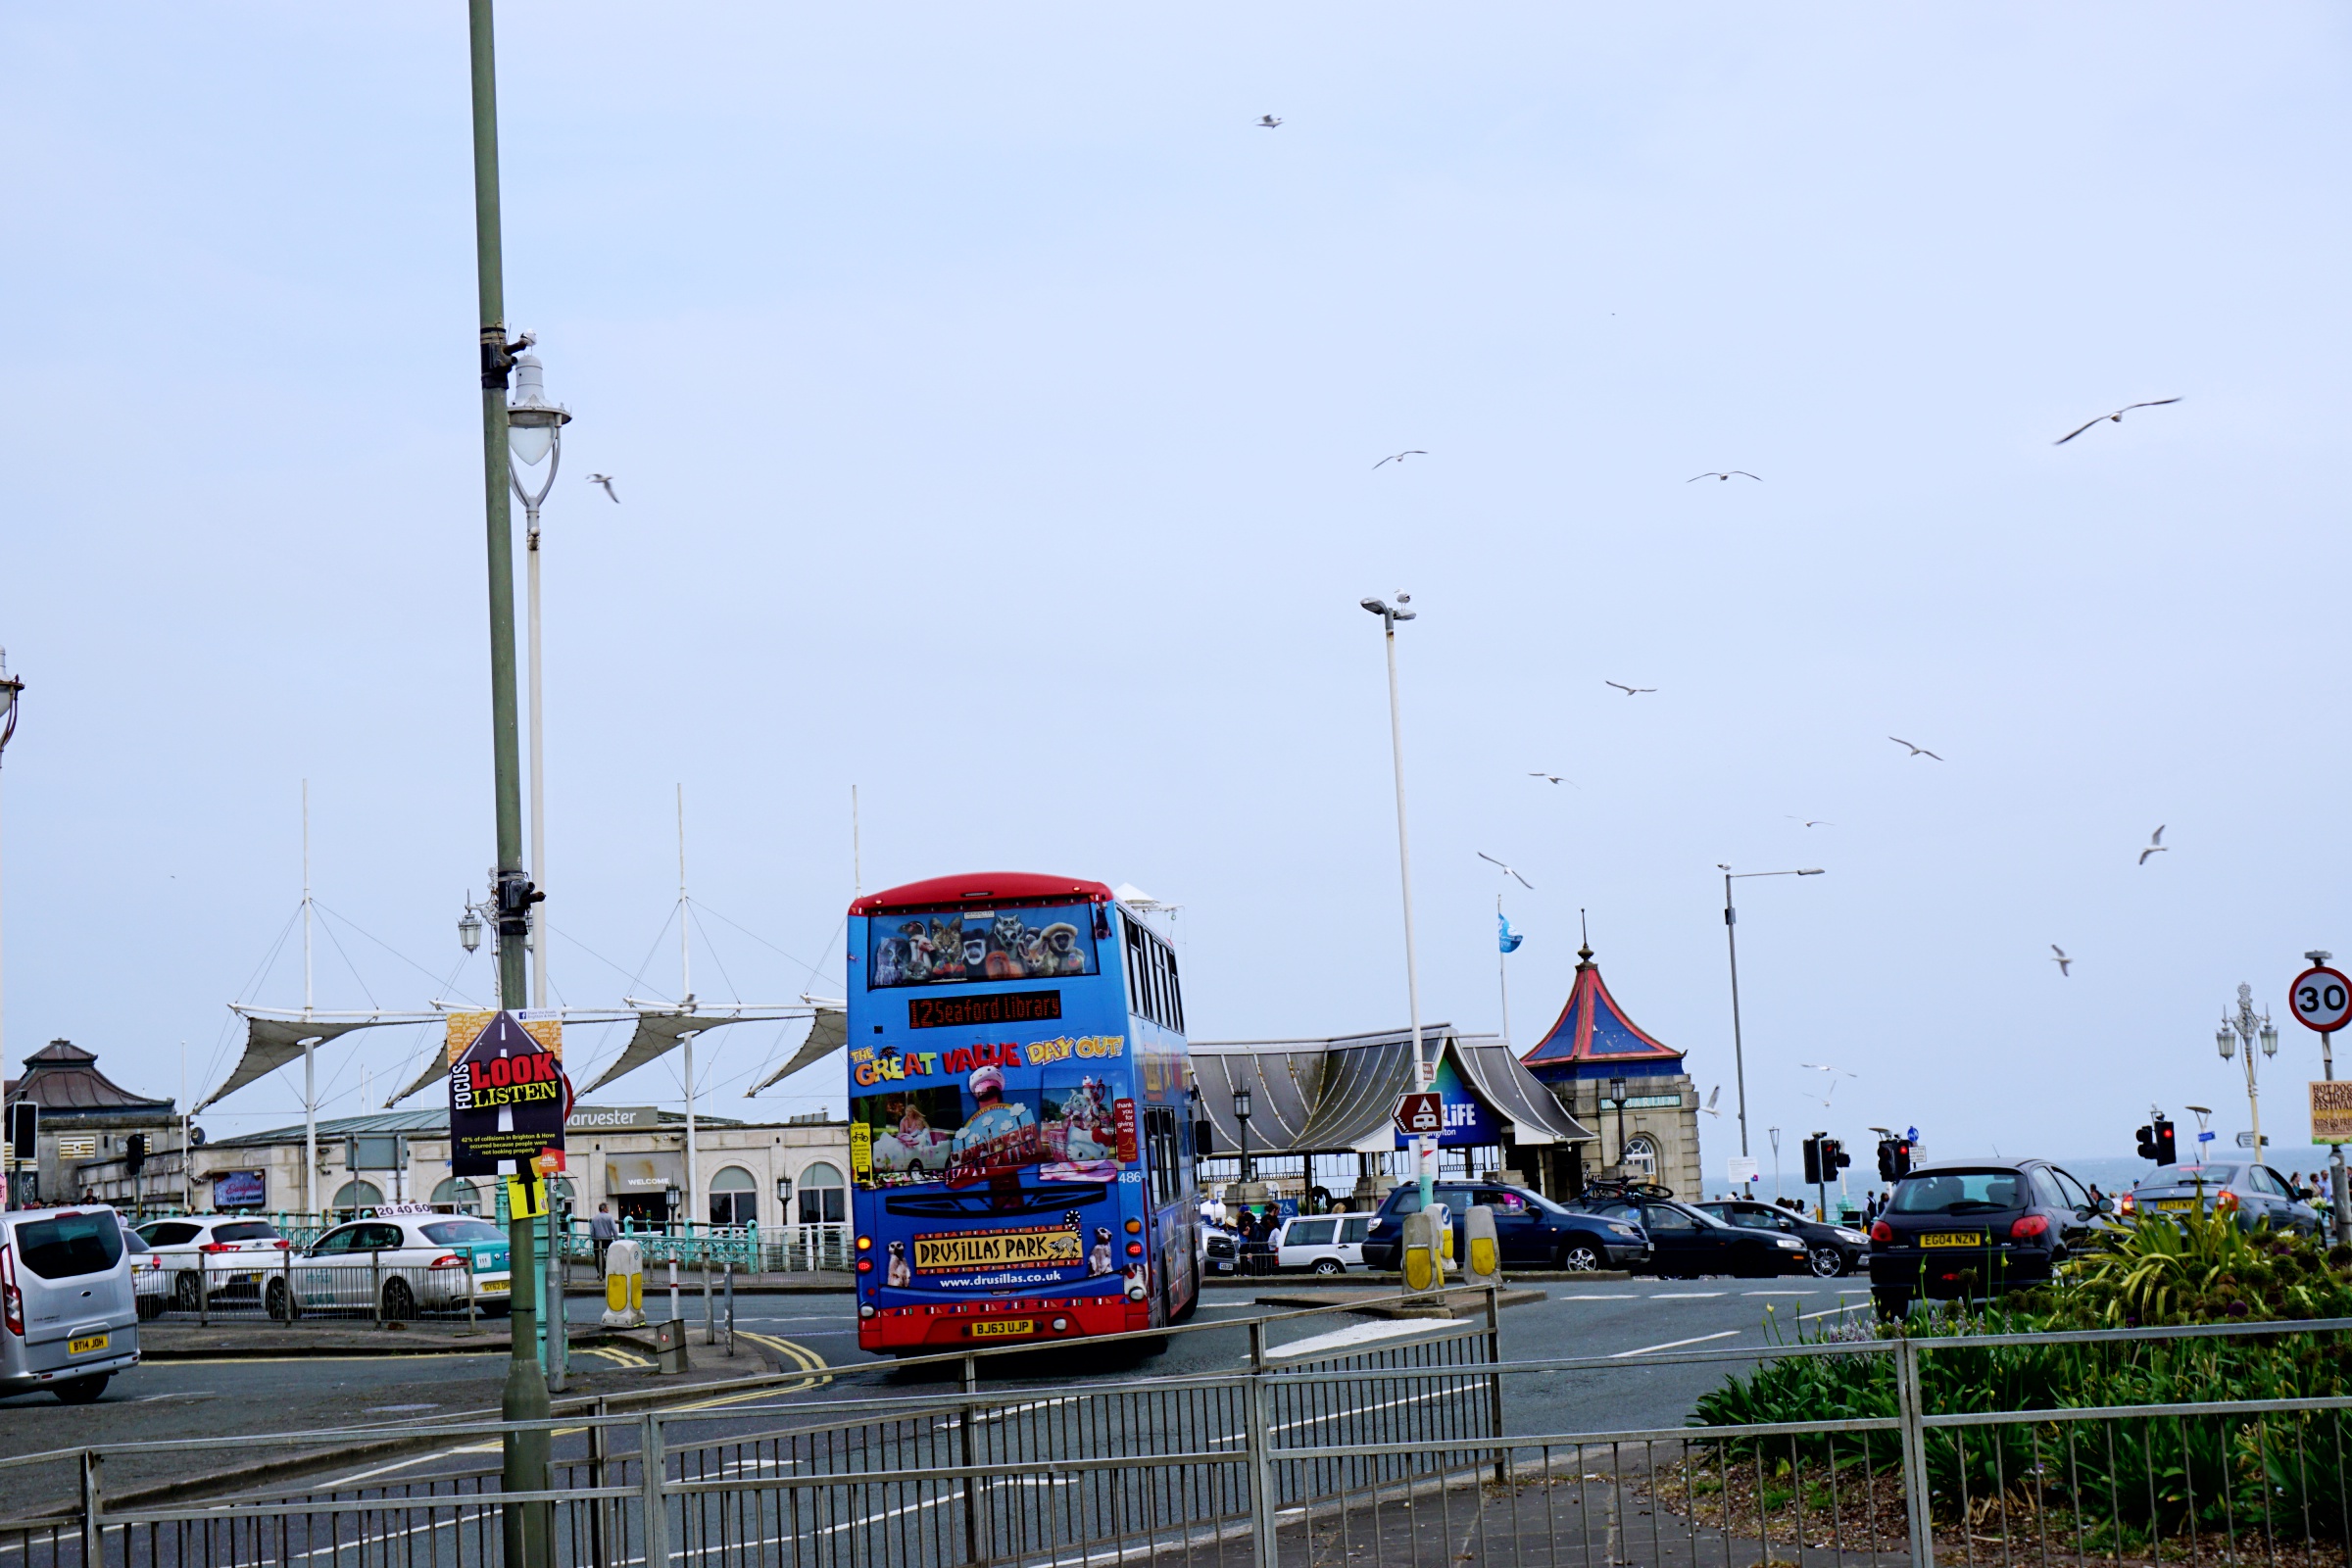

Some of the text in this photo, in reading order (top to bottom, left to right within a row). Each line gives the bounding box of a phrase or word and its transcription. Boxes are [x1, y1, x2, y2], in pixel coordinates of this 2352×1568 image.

[2298, 985, 2346, 1012] 30
[910, 996, 1059, 1028] 12 Seaford Library
[850, 1045, 875, 1064] THE
[943, 1043, 1021, 1074] VALUE
[1026, 1036, 1123, 1065] DAY OUT!
[469, 1052, 556, 1090] LOOK
[855, 1052, 937, 1086] GREAT
[452, 1063, 472, 1110] FOCUS
[472, 1081, 558, 1107] LISTEN
[2313, 1085, 2331, 1094] HOT
[1605, 1096, 1677, 1109] AUARIUM
[1118, 1171, 1142, 1184] 486
[377, 1207, 394, 1216] 20
[415, 1203, 430, 1212] 60
[1005, 1237, 1047, 1258] PARK
[1925, 1234, 1977, 1245] EG04 NZN
[940, 1270, 1061, 1288] www.drusillas.co.uk
[977, 1321, 1029, 1334] BJ63 UJP
[74, 1341, 89, 1351] BT14
